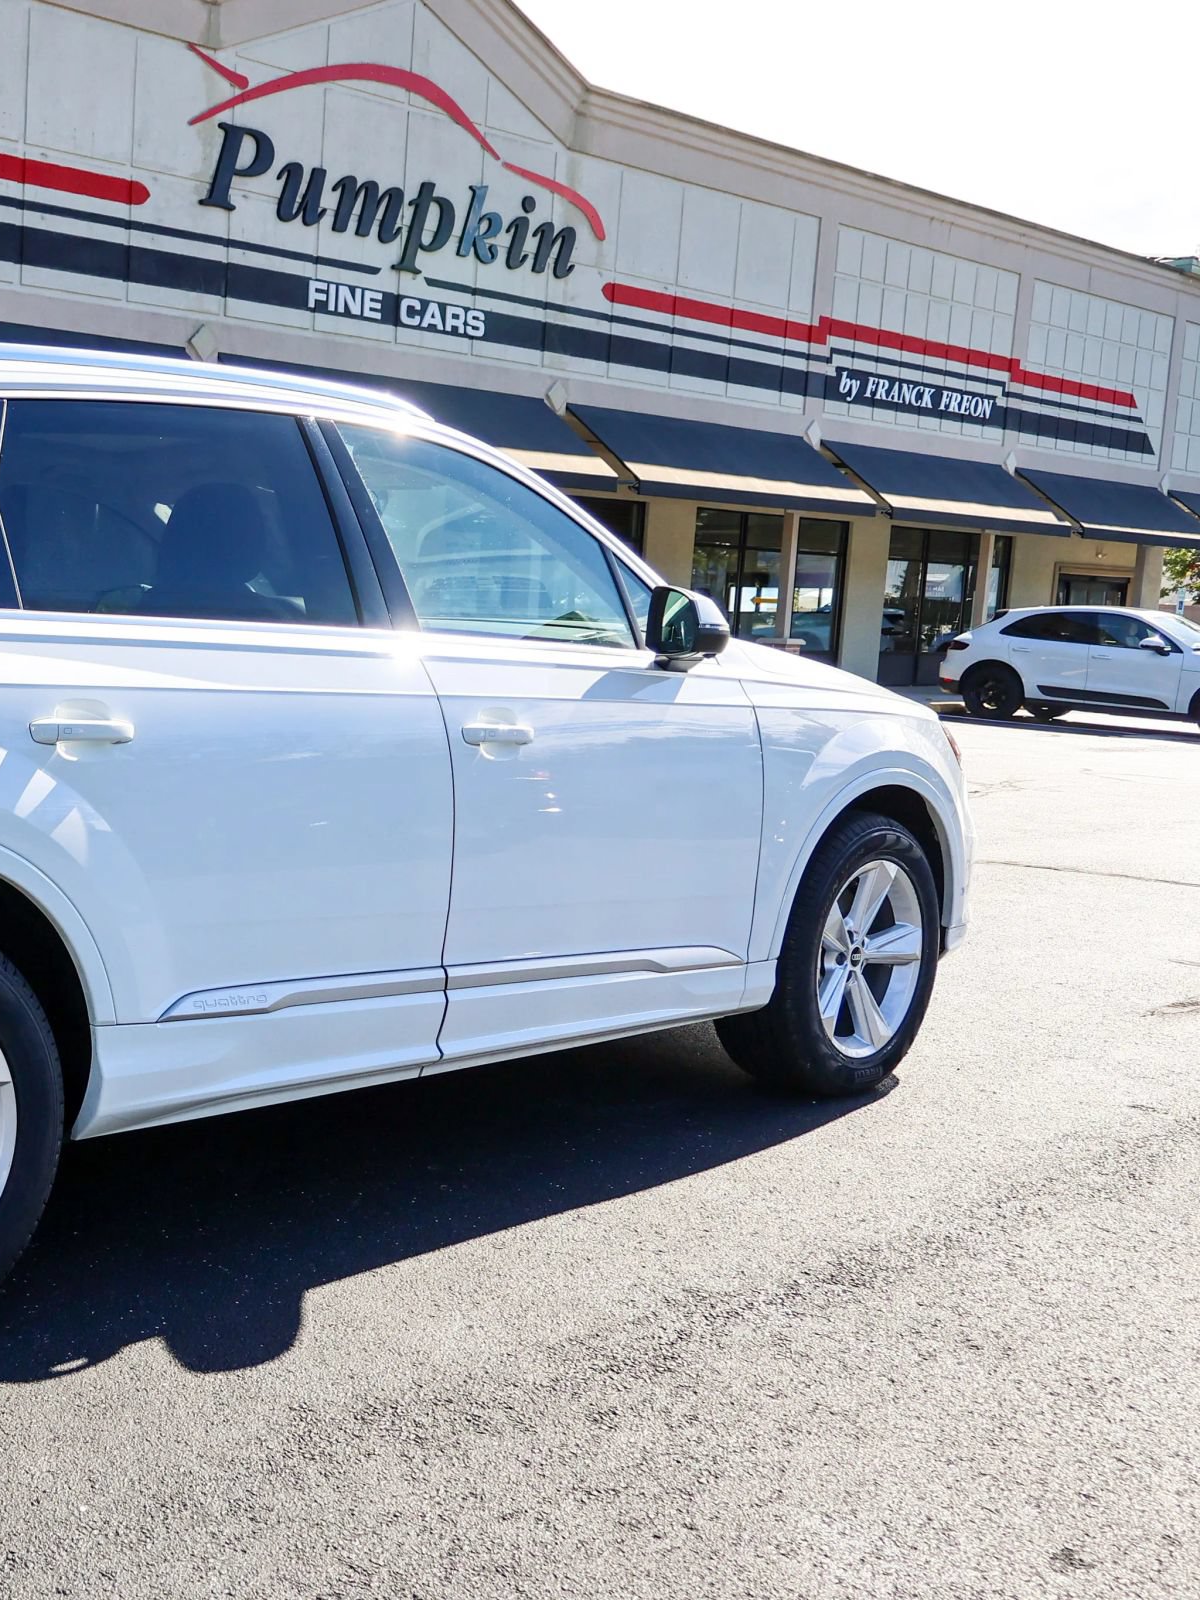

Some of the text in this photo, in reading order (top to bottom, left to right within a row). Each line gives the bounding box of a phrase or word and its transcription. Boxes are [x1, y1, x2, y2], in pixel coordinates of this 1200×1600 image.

[198, 121, 577, 280] Pumpkin
[307, 279, 486, 338] FINE CARS
[838, 370, 994, 420] by FRANCK FREON
[192, 994, 268, 1011] quattro
